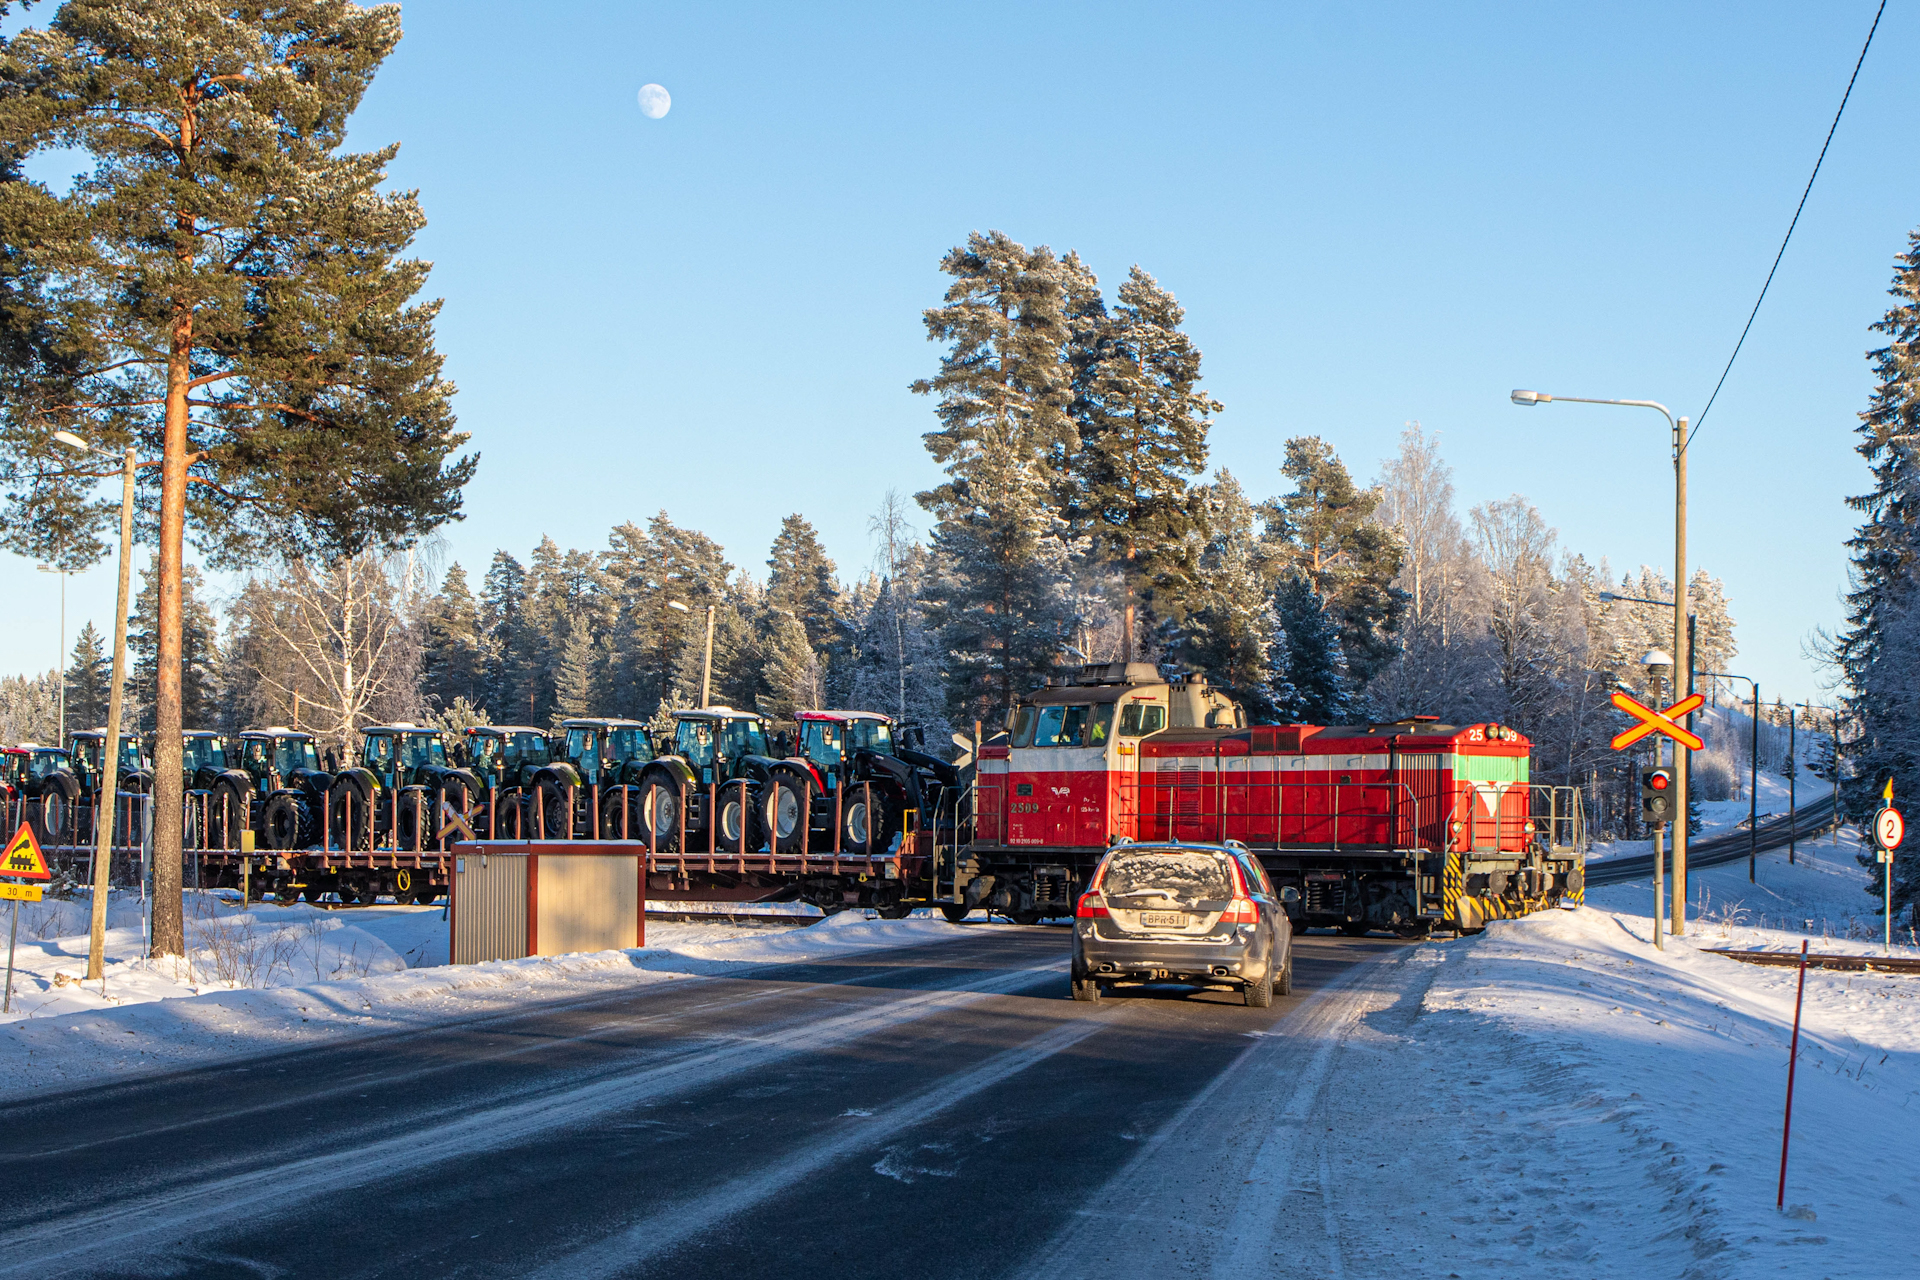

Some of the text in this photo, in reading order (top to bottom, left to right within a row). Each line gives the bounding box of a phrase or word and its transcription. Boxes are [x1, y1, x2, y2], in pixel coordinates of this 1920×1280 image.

[1469, 729, 1483, 741] 25
[1010, 803, 1039, 813] 2509
[1886, 819, 1894, 838] 2
[7, 887, 18, 896] 30
[1148, 914, 1186, 925] BPR-511
